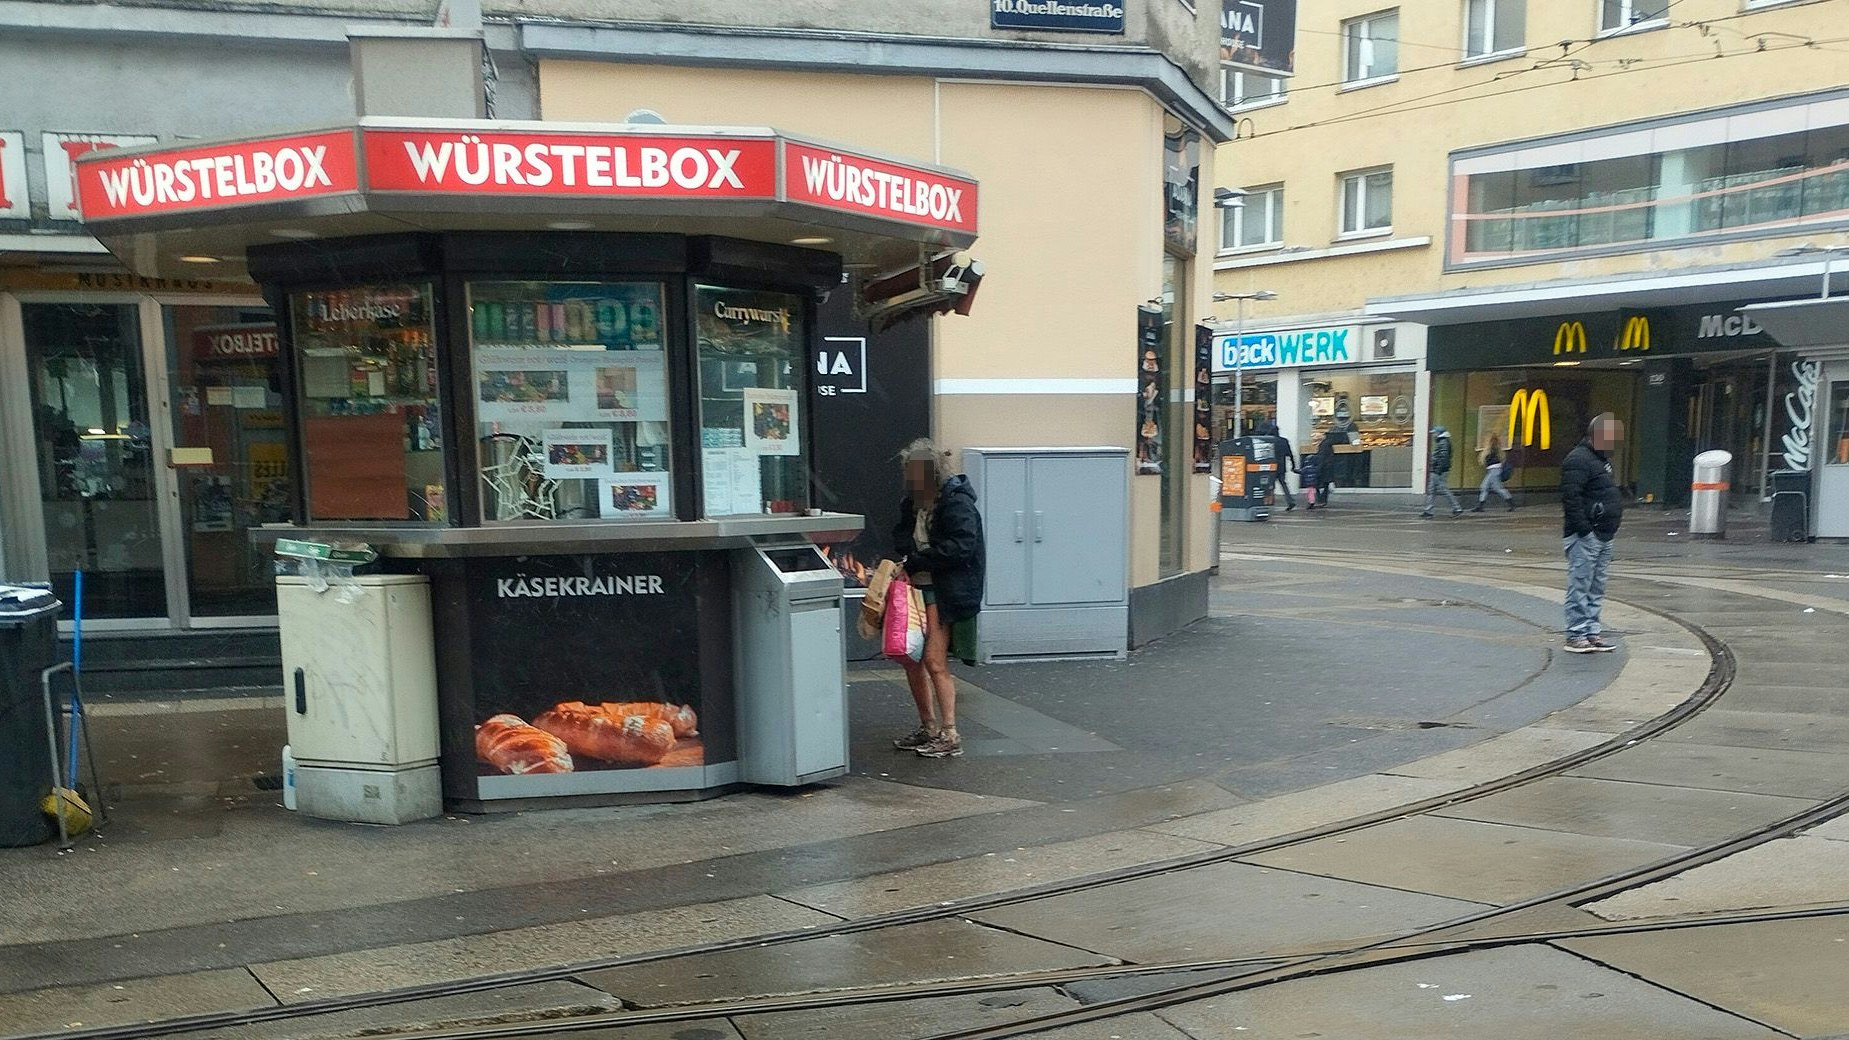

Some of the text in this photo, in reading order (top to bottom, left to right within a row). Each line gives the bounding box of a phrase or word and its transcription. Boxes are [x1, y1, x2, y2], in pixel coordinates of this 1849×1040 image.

[98, 145, 333, 209] WÜRSTELBOX
[403, 134, 745, 189] WÜRSTELBOX
[802, 154, 963, 223] WÜRSTELBOX
[496, 573, 664, 598] KÄSEKRAINER
